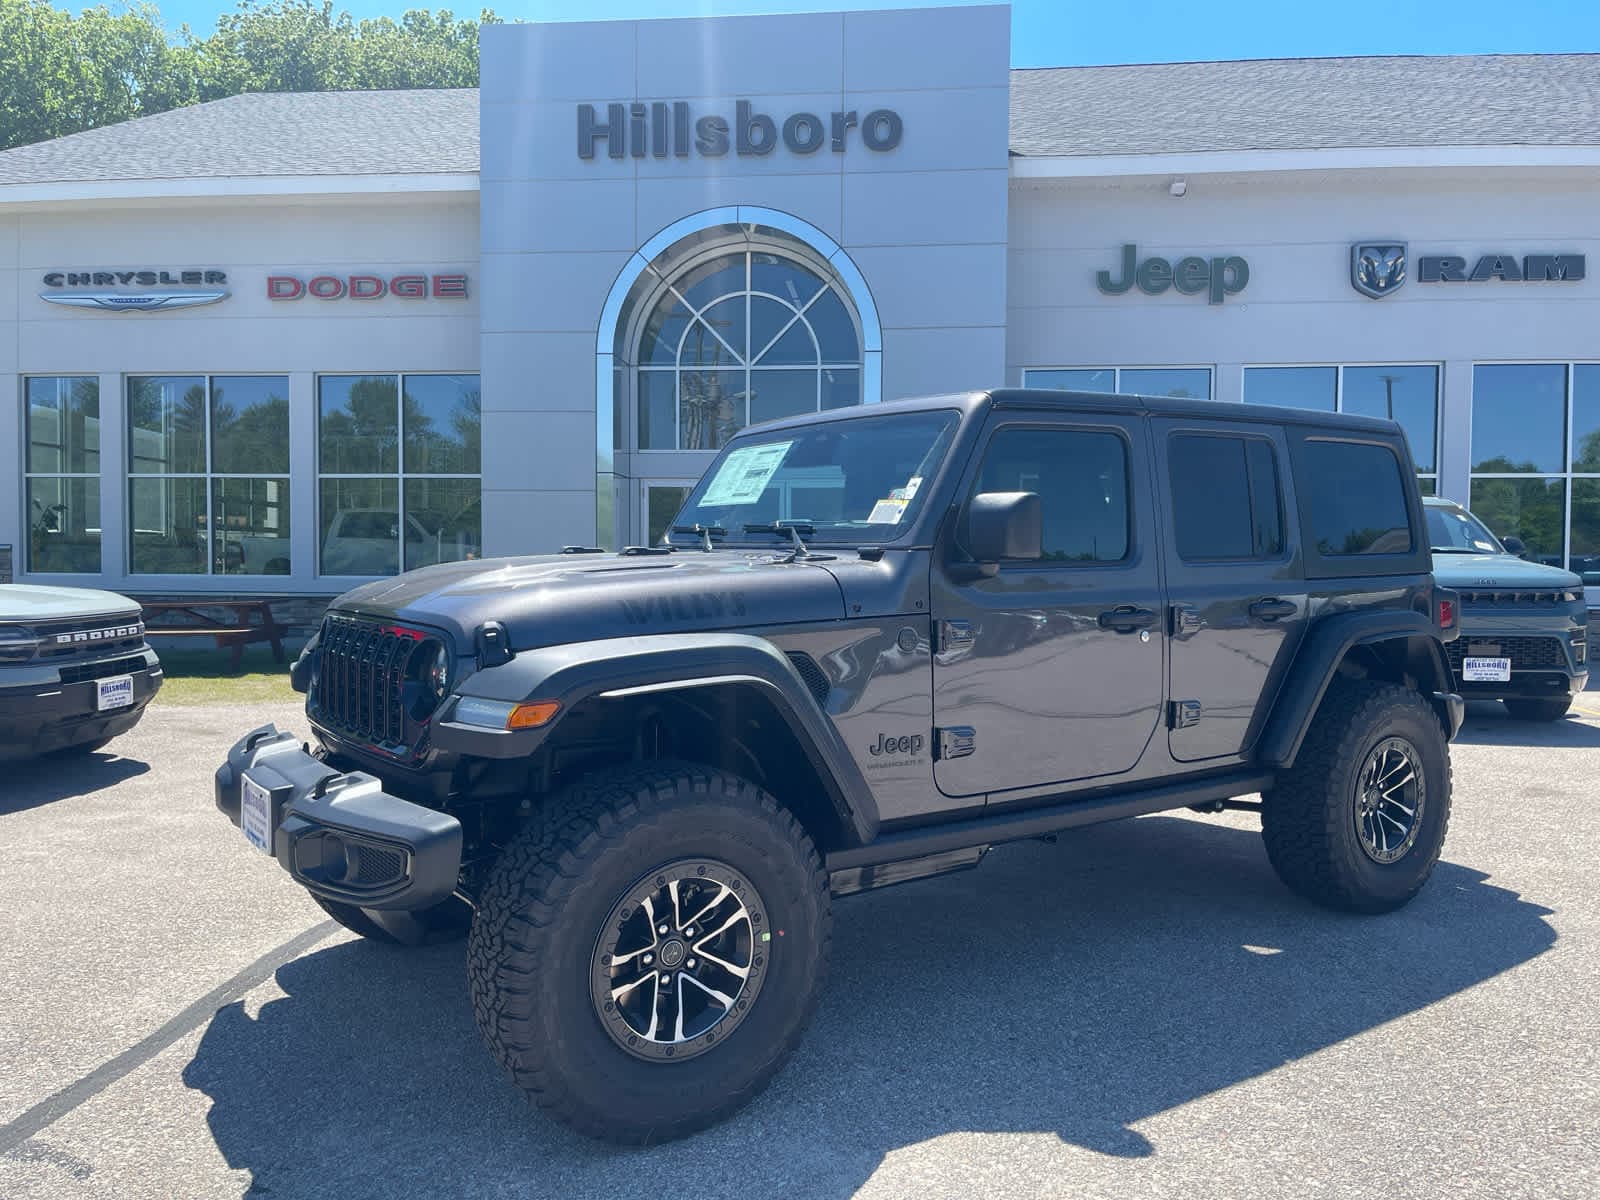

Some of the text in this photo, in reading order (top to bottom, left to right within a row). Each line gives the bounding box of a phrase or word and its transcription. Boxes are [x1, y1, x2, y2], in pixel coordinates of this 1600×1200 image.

[576, 99, 904, 160] Hillsboro
[43, 270, 227, 288] CHRYSLER
[1096, 243, 1250, 304] Jeep
[1418, 253, 1587, 283] RAM
[267, 274, 468, 302] DODGE
[616, 591, 746, 625] WILLYS
[56, 627, 137, 643] BRONCO
[869, 733, 923, 756] Jeep
